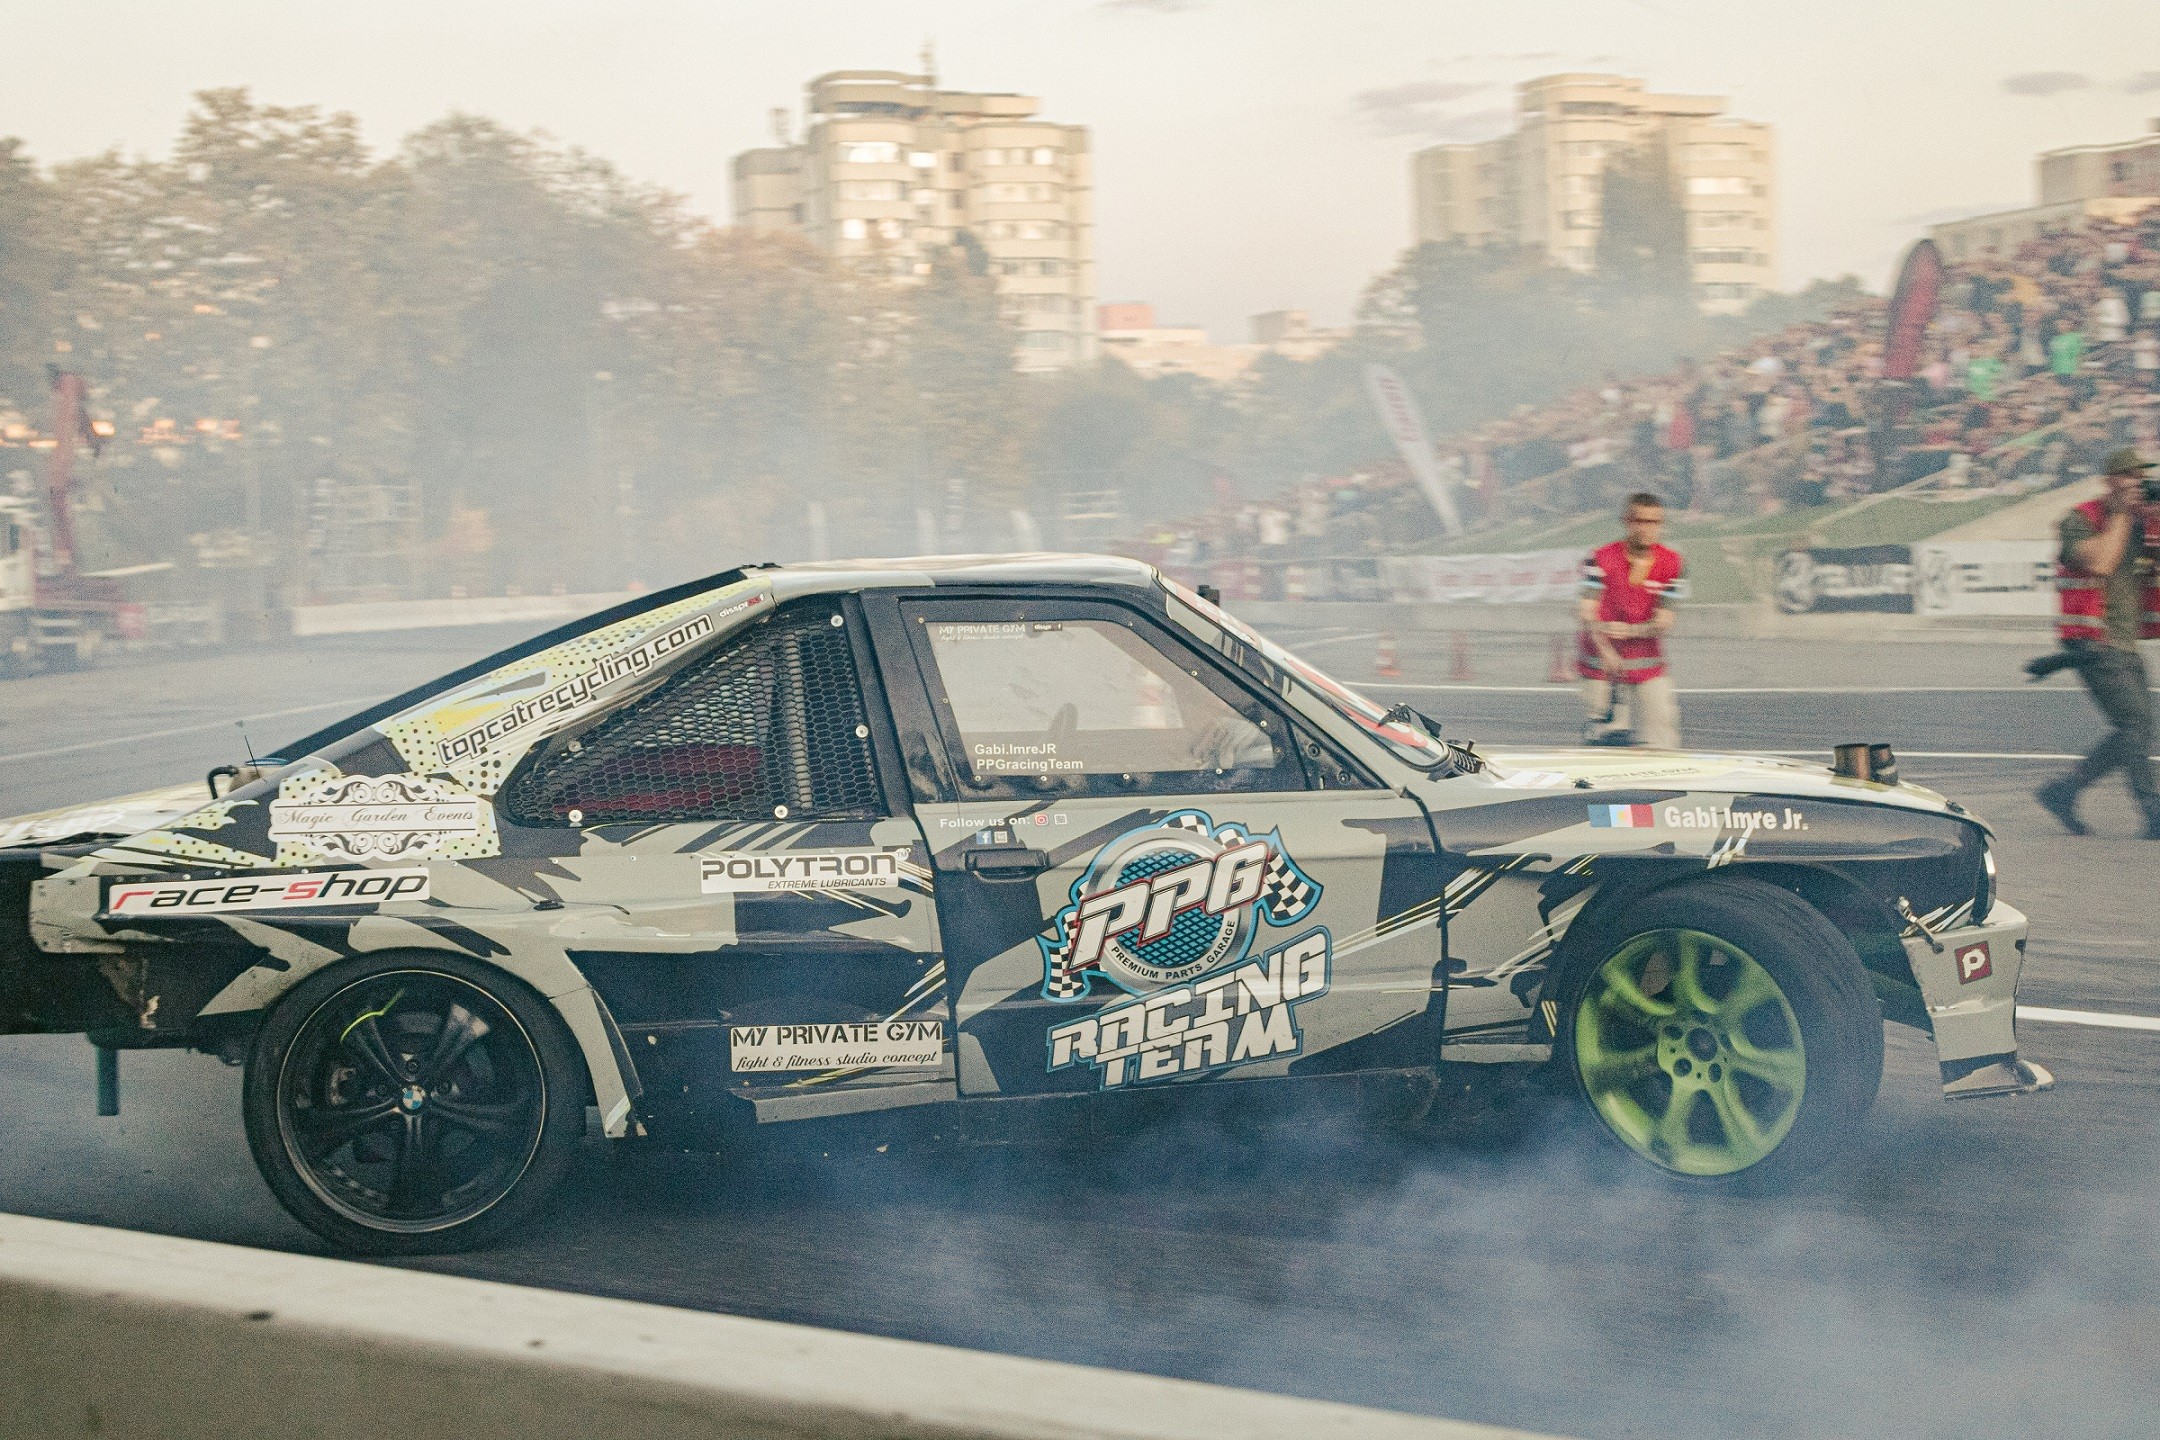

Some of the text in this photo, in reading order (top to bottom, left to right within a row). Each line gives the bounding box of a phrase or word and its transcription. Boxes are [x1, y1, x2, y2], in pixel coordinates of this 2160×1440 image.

[957, 625, 999, 634] PRIVATE
[441, 615, 712, 761] topcatrecycling.com
[974, 743, 1057, 755] Gabi.ImreJR
[976, 758, 1083, 772] PPGracingTeam
[275, 805, 474, 829] Magic Garden Events
[940, 817, 1031, 828] Follow us on:
[1664, 806, 1809, 831] Gabi Imre Jr.
[702, 854, 897, 880] POLYTRON
[112, 873, 428, 910] race-shop
[767, 878, 887, 889] EXTREME LUBRICANTS
[1069, 843, 1266, 970] PPG
[1110, 919, 1236, 980] PREMIUM PARTS GARAGE
[1962, 948, 1986, 979] P
[1051, 933, 1327, 1067] RACING
[732, 1022, 941, 1047] MY PRIVATE GYM
[1096, 1002, 1297, 1086] TEAM
[735, 1050, 938, 1070] fight & fitness studio concept
